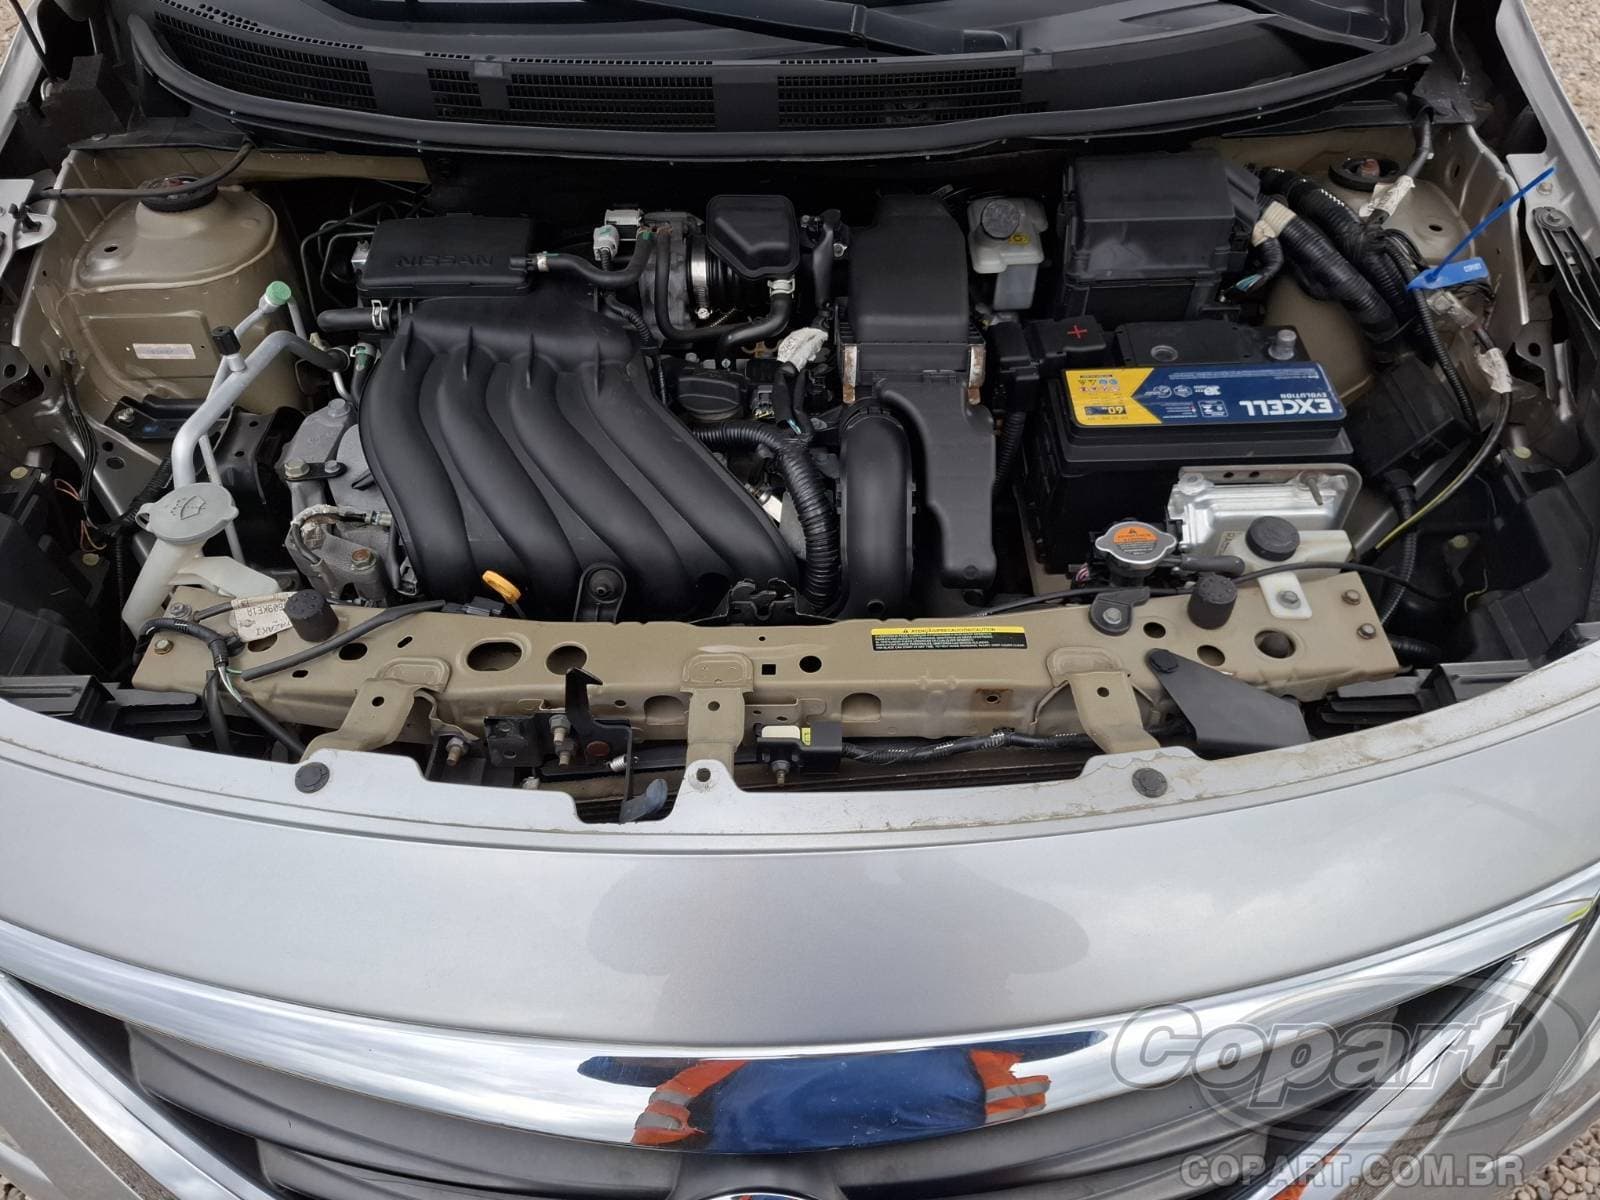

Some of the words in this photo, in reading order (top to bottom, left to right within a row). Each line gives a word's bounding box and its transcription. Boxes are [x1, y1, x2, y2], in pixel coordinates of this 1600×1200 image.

[397, 255, 494, 267] NISSAN
[1280, 391, 1327, 399] EVOLUTION
[1108, 406, 1124, 414] 60
[1239, 398, 1334, 417] EXCELL
